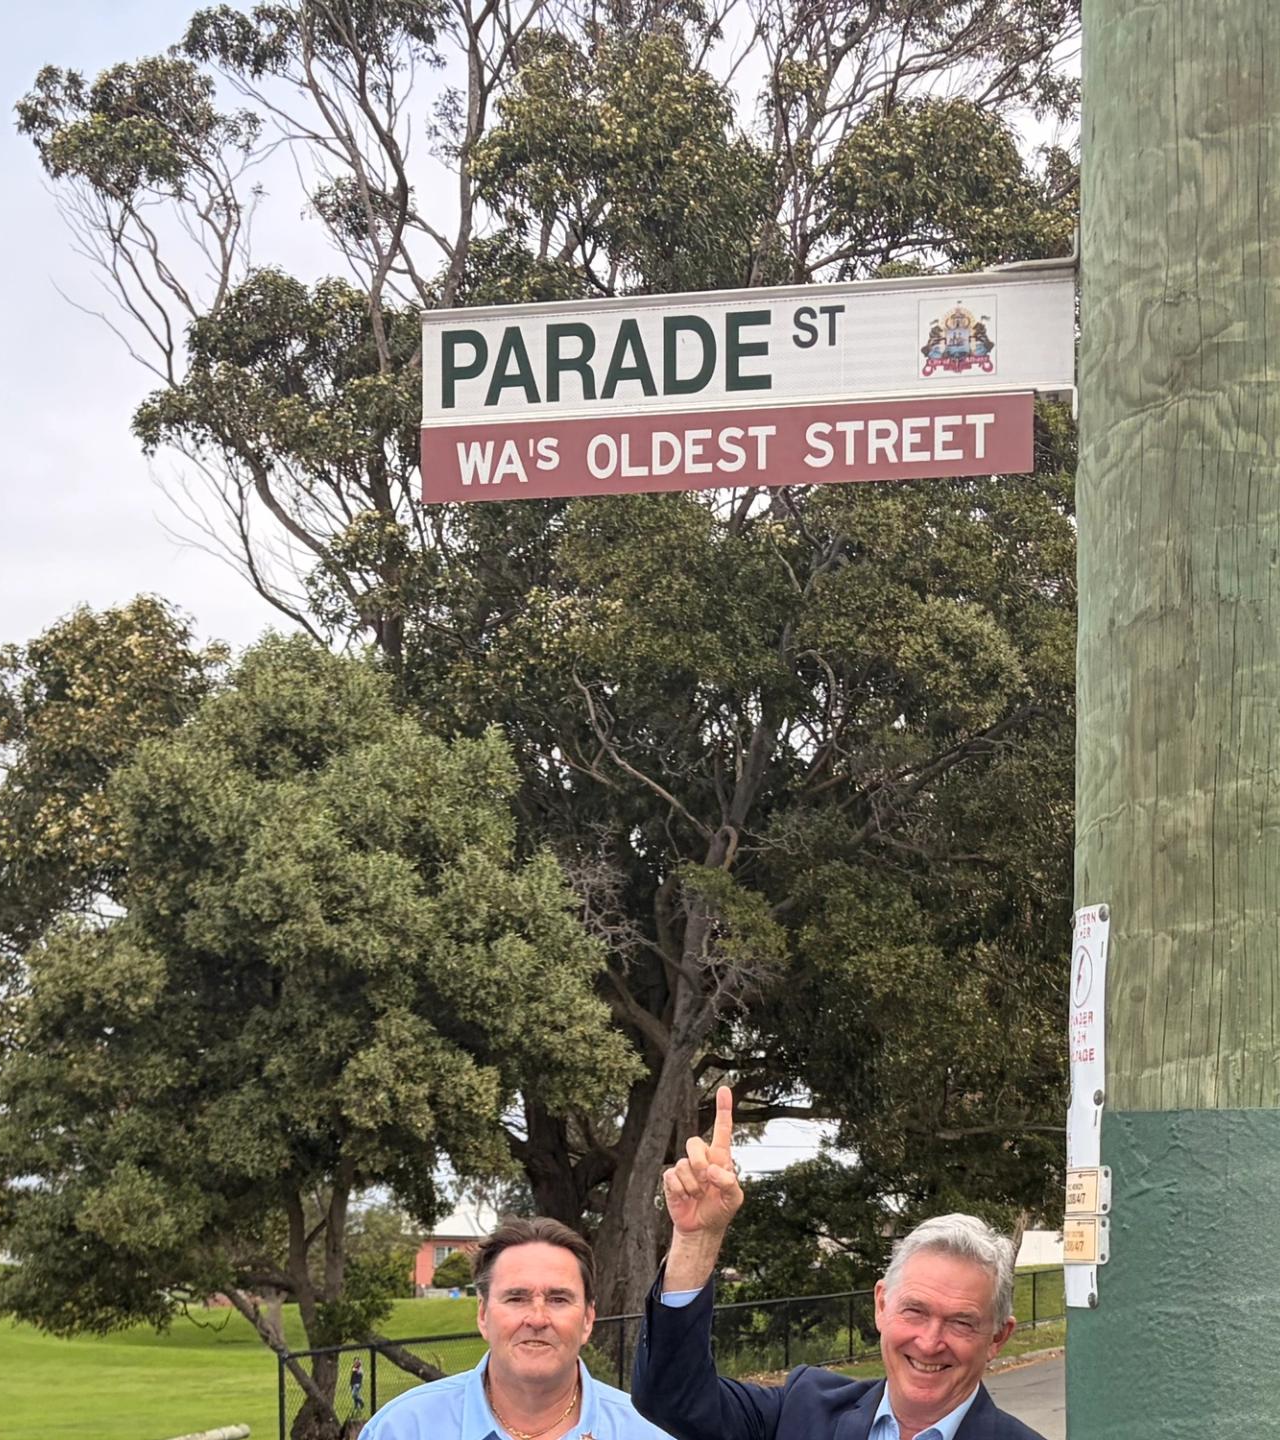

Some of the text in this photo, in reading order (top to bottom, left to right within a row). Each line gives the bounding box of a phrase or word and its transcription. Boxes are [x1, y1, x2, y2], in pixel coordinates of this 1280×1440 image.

[441, 304, 845, 409] PARADE ST
[586, 426, 777, 480] OLDEST
[803, 413, 995, 468] STREET
